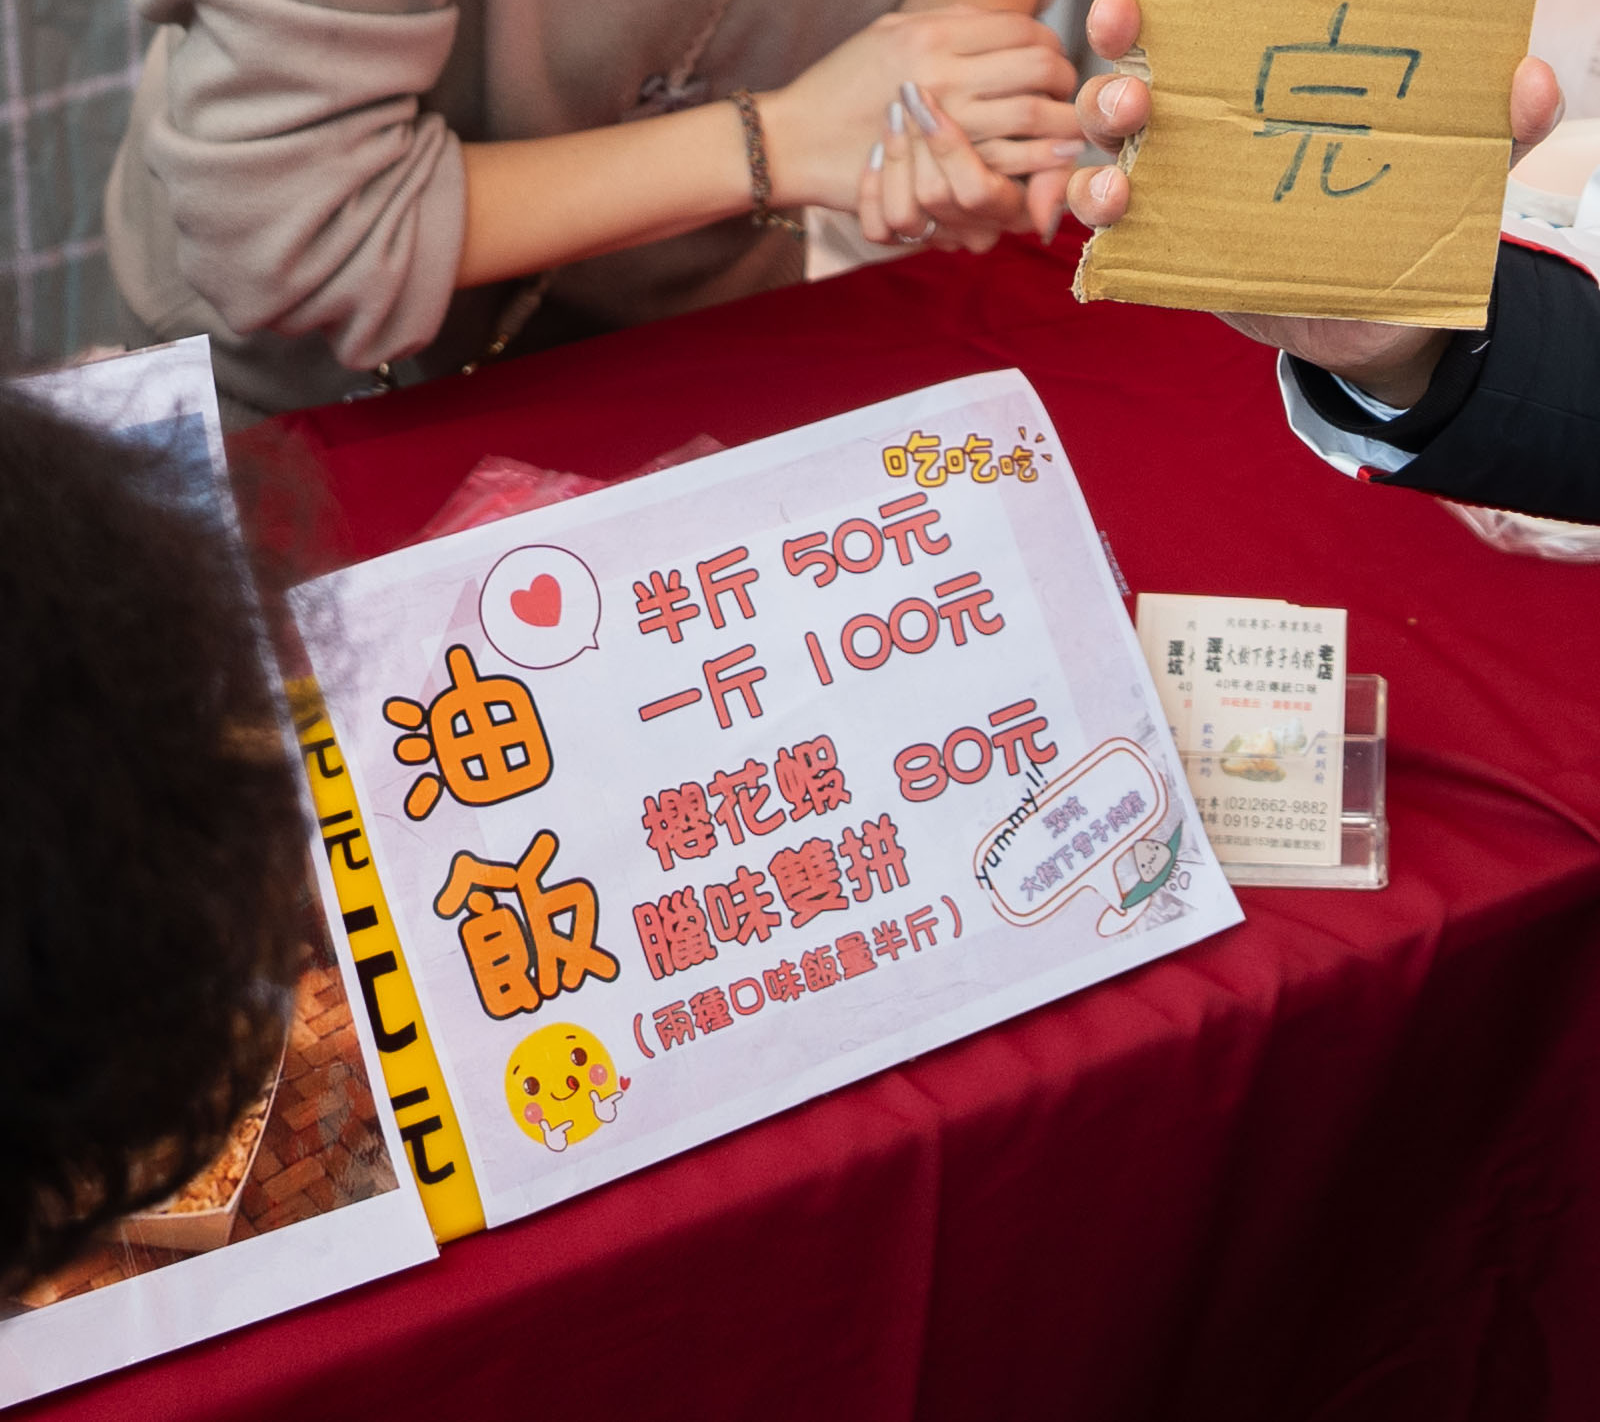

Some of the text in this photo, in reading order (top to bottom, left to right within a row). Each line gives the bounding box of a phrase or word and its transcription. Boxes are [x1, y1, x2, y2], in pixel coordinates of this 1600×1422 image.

[882, 430, 1038, 488] 吃吃吃
[632, 491, 952, 644] 半斤 50元
[638, 571, 1006, 730] 一斤 100元
[1204, 636, 1224, 673] 深坑
[1317, 643, 1335, 680] 老店
[641, 697, 1059, 872] 櫻花蝦 80元
[632, 813, 910, 981] 臘味雙拼
